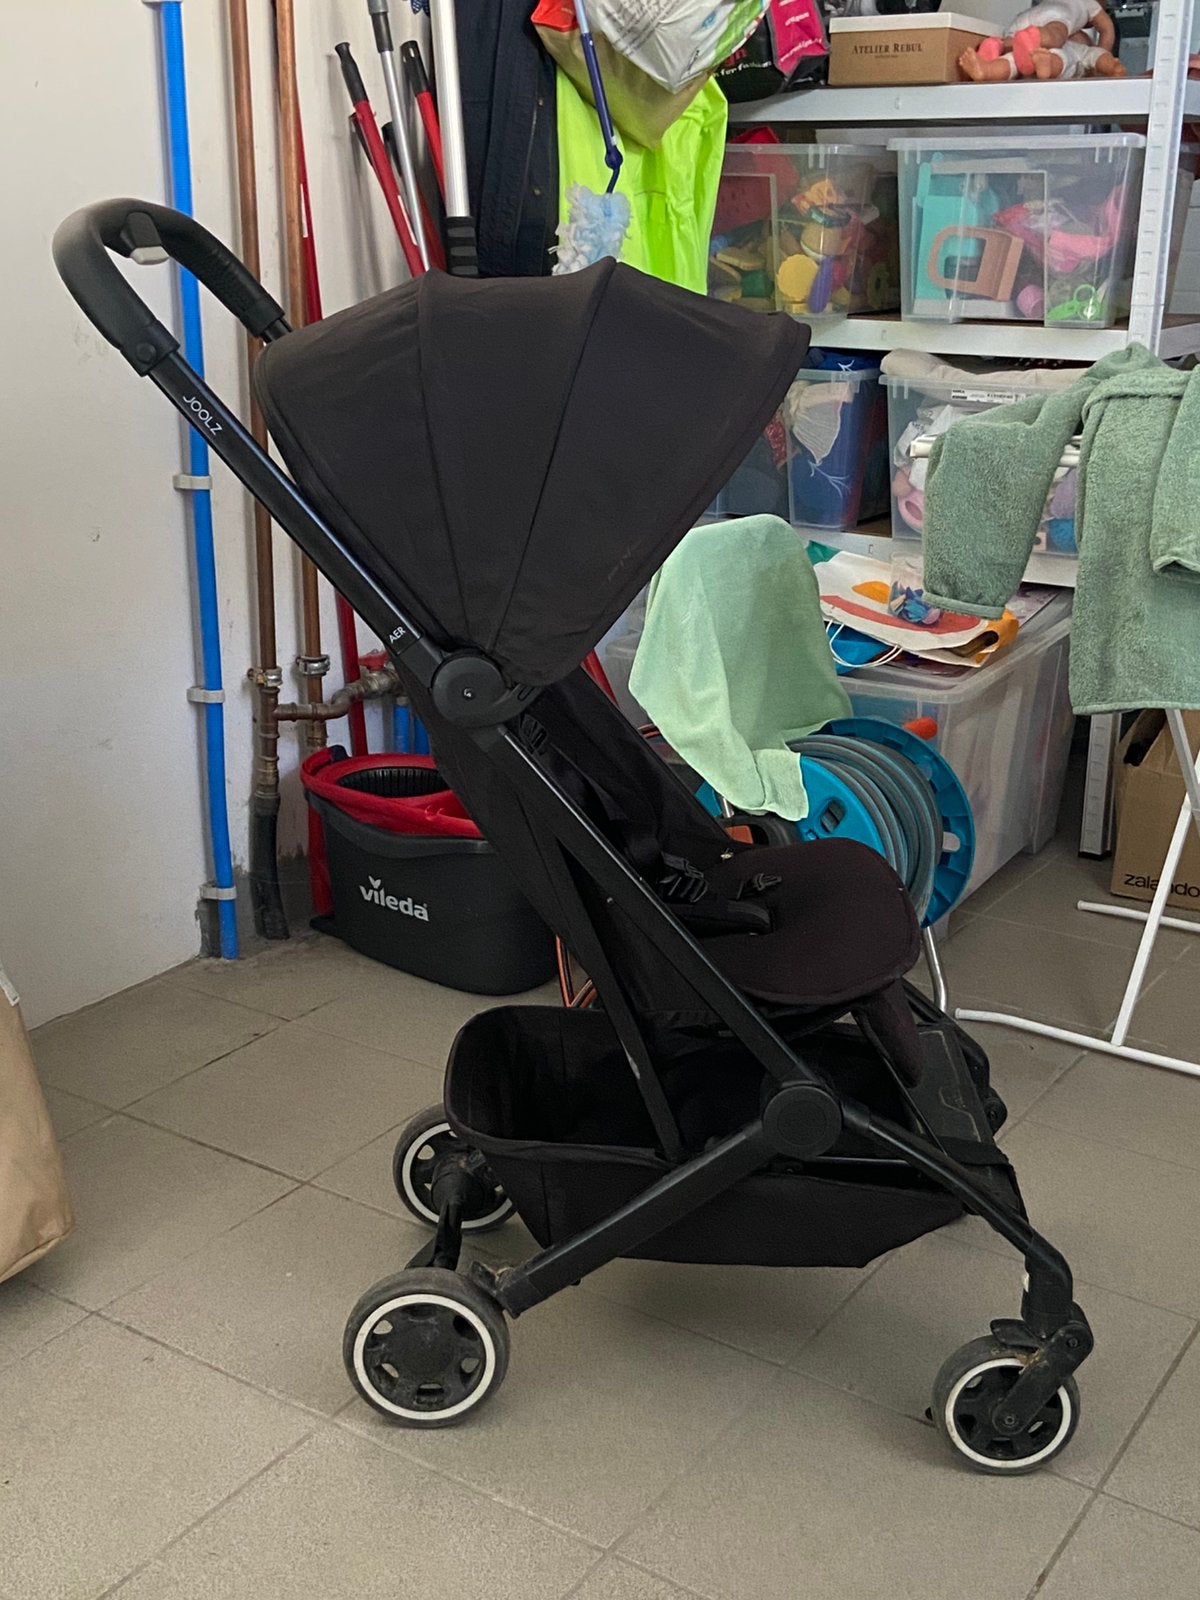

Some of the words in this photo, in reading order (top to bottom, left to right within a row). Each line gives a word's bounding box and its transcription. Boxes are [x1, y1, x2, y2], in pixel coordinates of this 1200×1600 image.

[852, 45, 890, 55] ATELIER
[893, 43, 923, 53] REBUL
[182, 396, 223, 436] JOOLZ
[389, 626, 406, 644] AER
[359, 875, 430, 922] vileda
